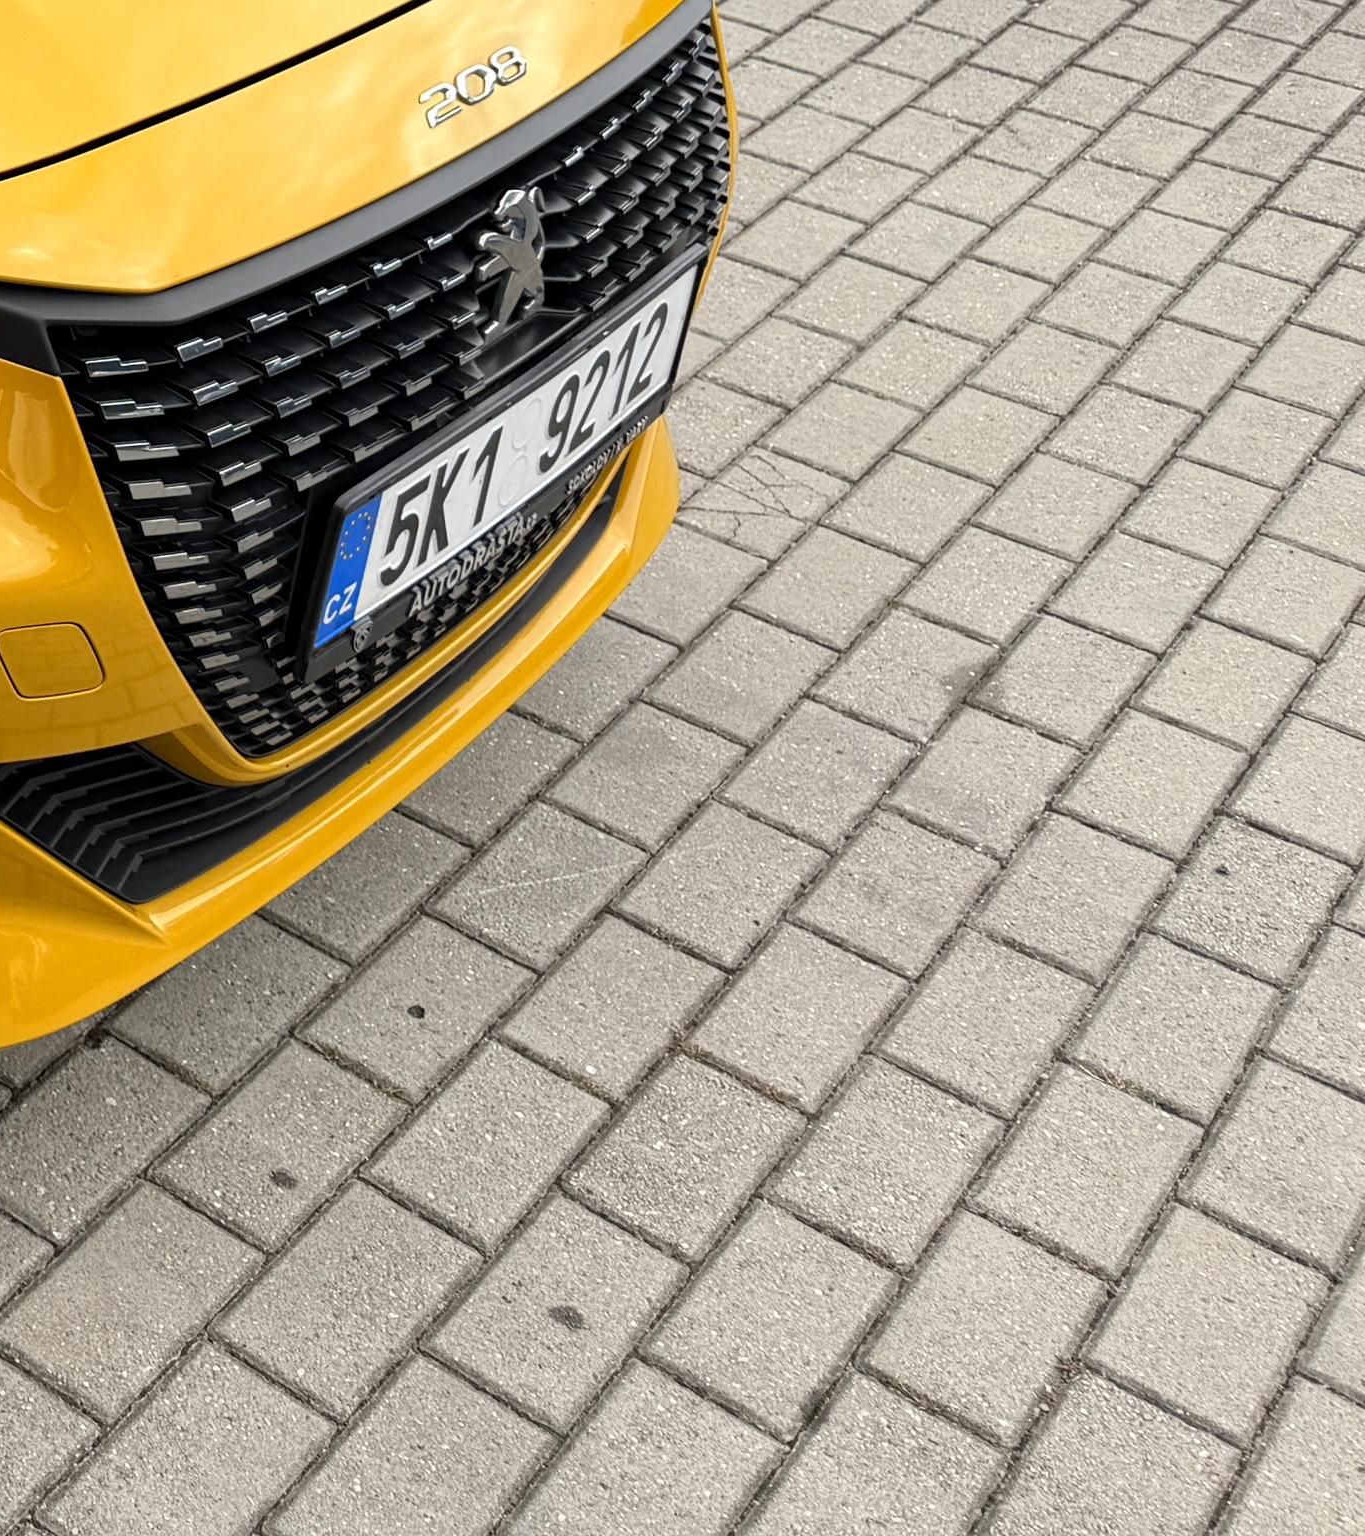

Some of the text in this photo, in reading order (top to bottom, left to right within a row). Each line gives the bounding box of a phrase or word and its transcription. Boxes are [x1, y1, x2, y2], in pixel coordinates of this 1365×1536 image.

[418, 44, 528, 129] 208
[323, 301, 669, 625] CZ 5K1 9212
